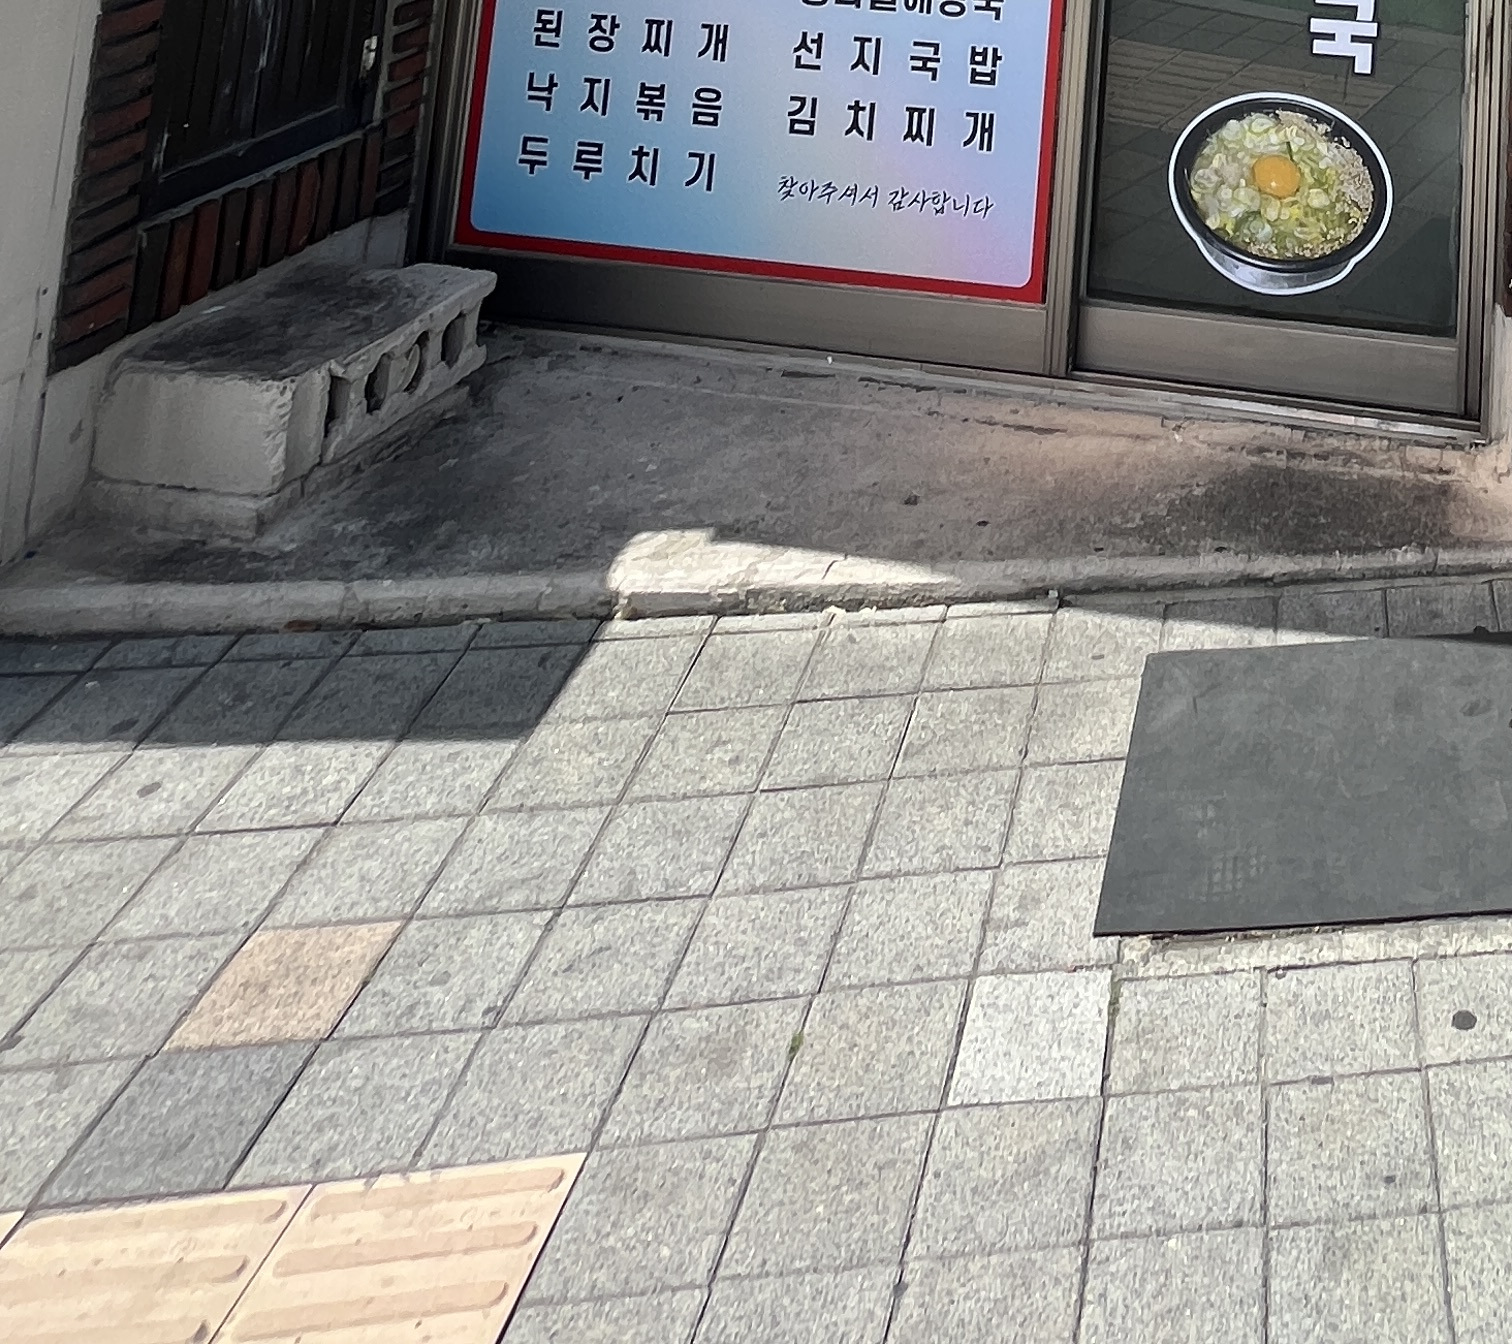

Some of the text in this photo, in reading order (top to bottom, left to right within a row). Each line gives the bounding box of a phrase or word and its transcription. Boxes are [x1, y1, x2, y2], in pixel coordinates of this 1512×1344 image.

[533, 9, 729, 62] 된장찌개
[793, 31, 1003, 86] 선지국밥
[527, 72, 722, 127] 낙지볶음
[787, 95, 995, 153] 김치찌개
[518, 135, 716, 192] 두루치기
[778, 175, 995, 219] 찾아주셔서 감사합니다
